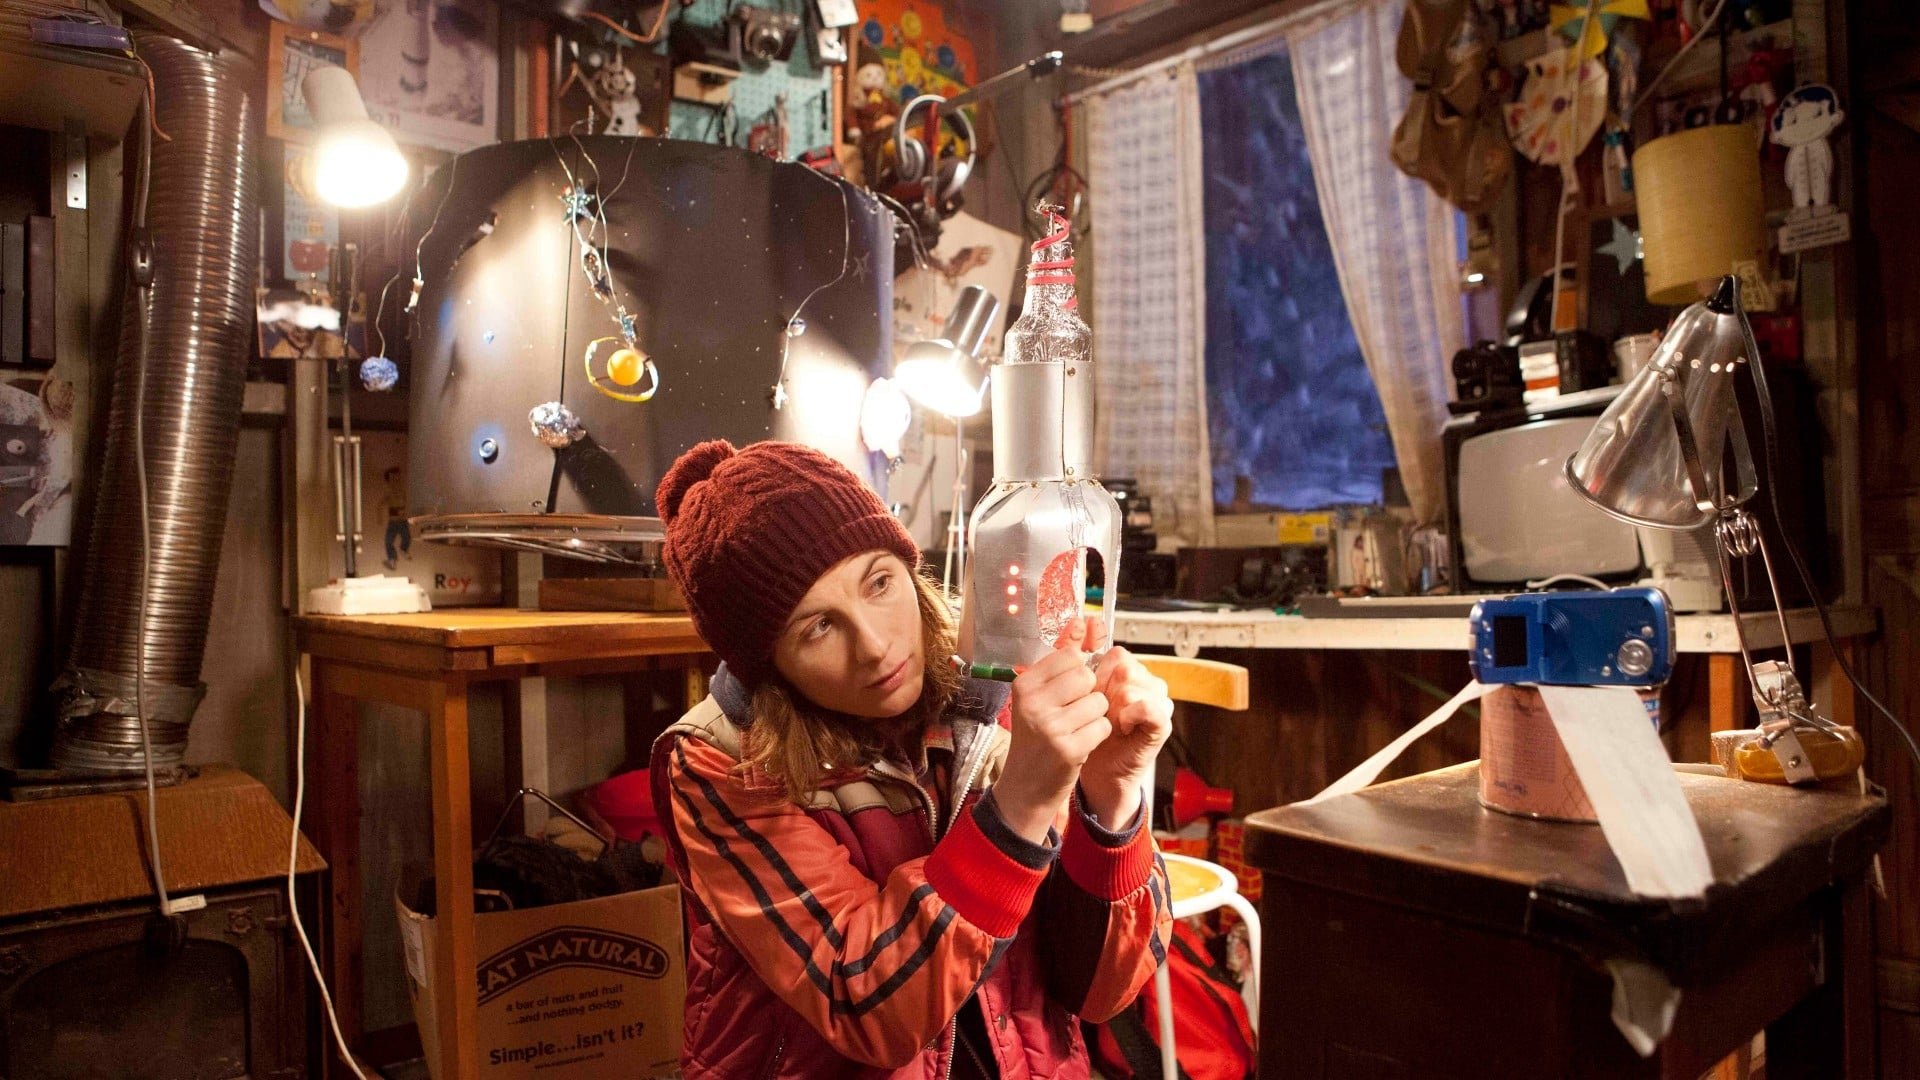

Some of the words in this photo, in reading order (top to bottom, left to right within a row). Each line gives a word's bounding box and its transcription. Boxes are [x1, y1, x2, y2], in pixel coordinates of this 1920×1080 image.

[435, 573, 471, 593] Roy
[525, 937, 656, 971] NATURAL
[506, 1004, 514, 1012] a
[515, 999, 535, 1010] bar
[537, 996, 549, 1007] of
[552, 993, 576, 1004] nuts
[579, 987, 599, 1000] and
[602, 984, 624, 995] fruit
[544, 1005, 585, 1020] nothing
[622, 1021, 645, 1041] it?
